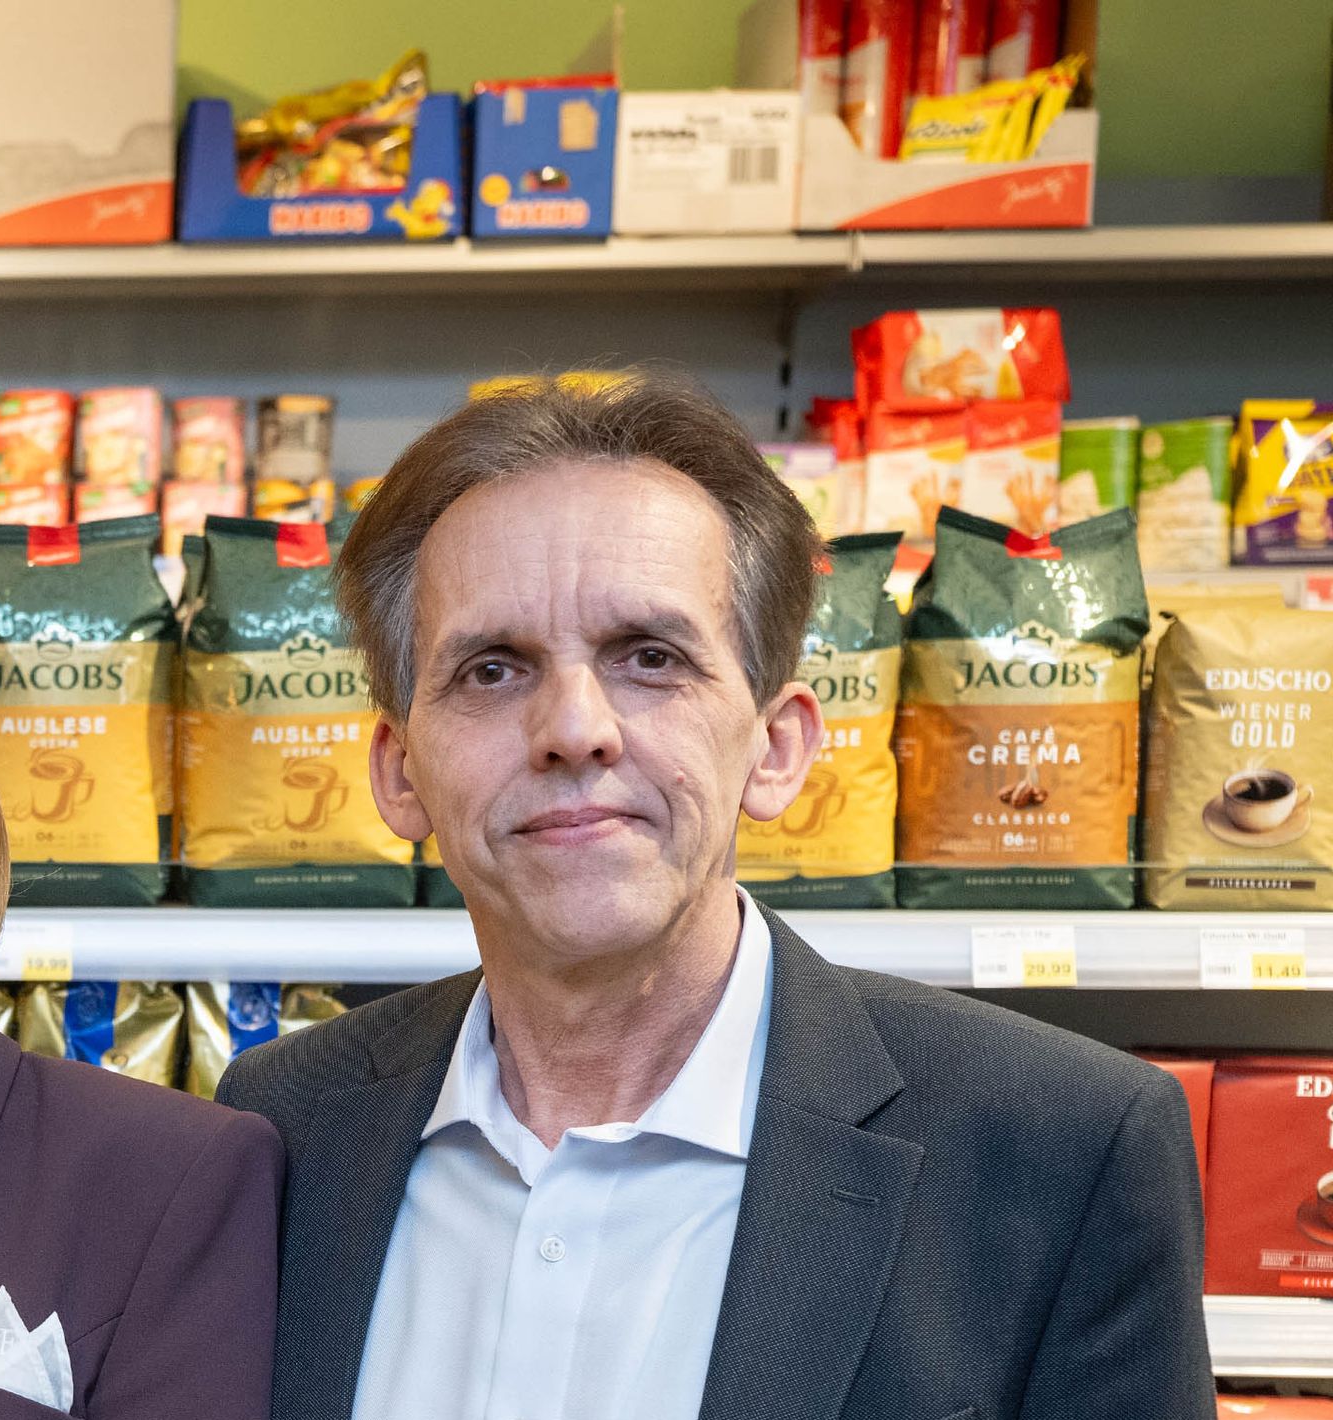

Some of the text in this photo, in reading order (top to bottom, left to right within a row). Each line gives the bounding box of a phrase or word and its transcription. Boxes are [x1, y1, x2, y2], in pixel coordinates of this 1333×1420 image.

[954, 661, 1098, 694] JACOBS
[1204, 667, 1332, 692] EDUSCHO
[812, 675, 878, 704] OBS
[1219, 701, 1313, 722] WIENER
[0, 716, 107, 734] AUSLESE
[251, 723, 361, 744] AUSLESE
[998, 725, 1056, 744] CAFÉ
[1230, 720, 1297, 749] GOLD
[967, 743, 1081, 766] CREMA
[972, 811, 1071, 826] CLASSICO
